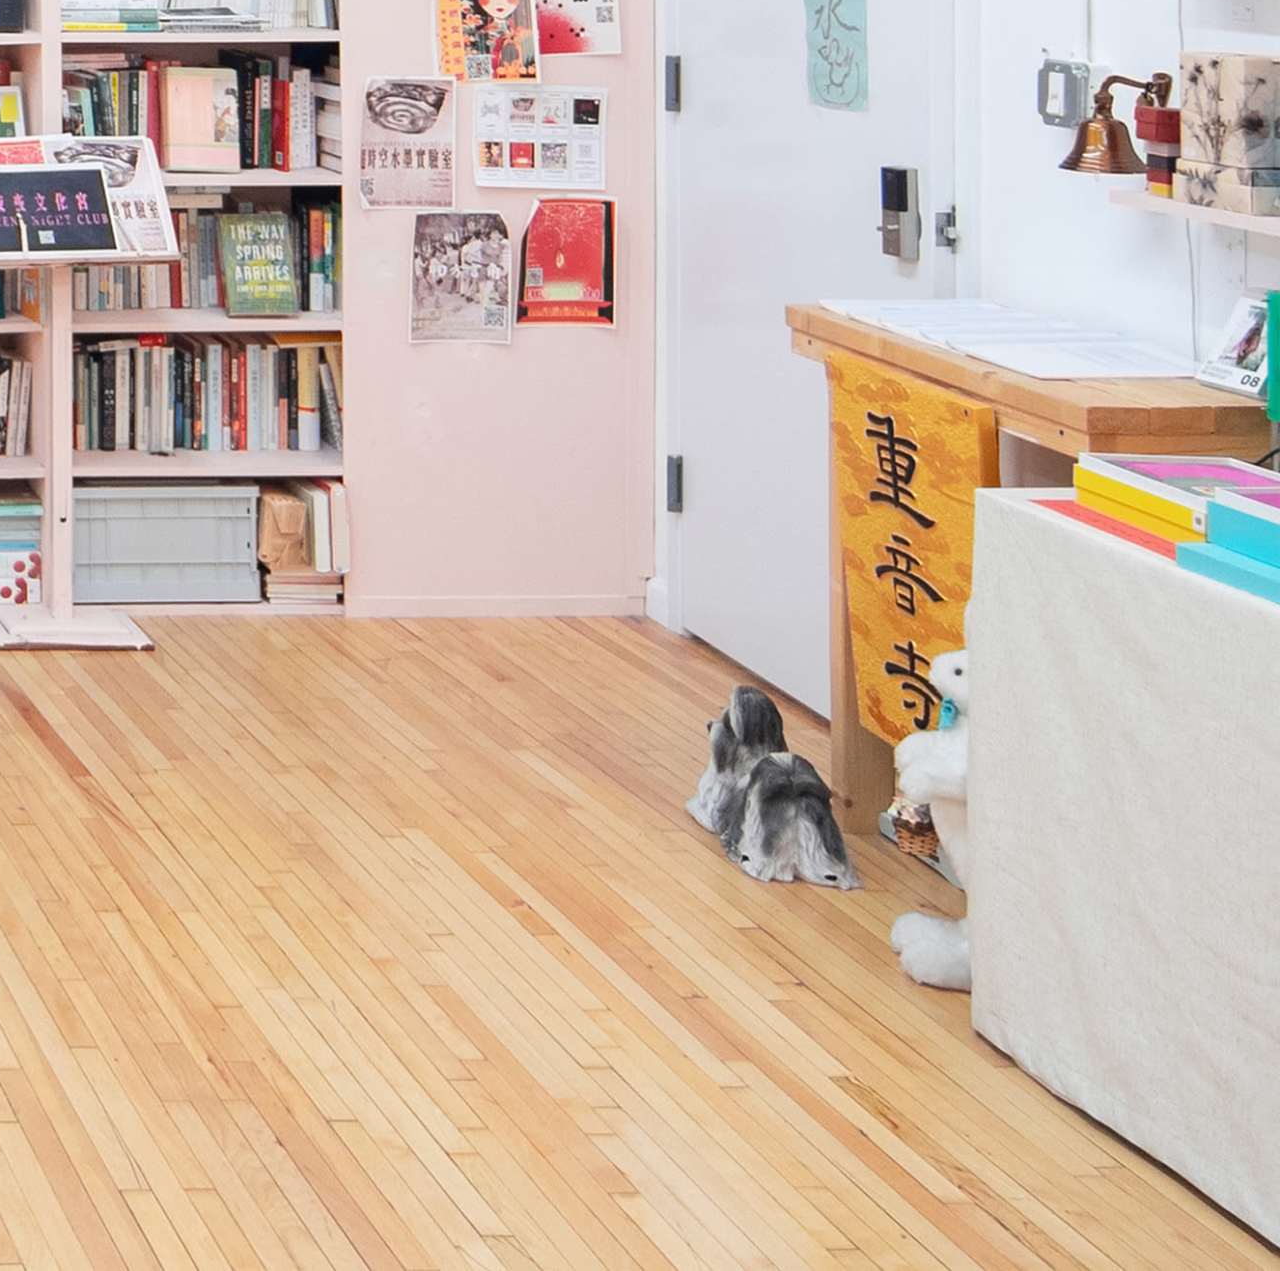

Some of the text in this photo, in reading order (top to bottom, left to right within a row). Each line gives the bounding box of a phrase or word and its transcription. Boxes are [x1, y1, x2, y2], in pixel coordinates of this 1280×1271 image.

[77, 213, 109, 226] CLUB
[230, 223, 285, 241] THE WAY
[236, 244, 284, 260] SPRING
[235, 265, 289, 282] ARRIVES
[1240, 374, 1261, 388] 08
[864, 410, 947, 731] 重音寺
